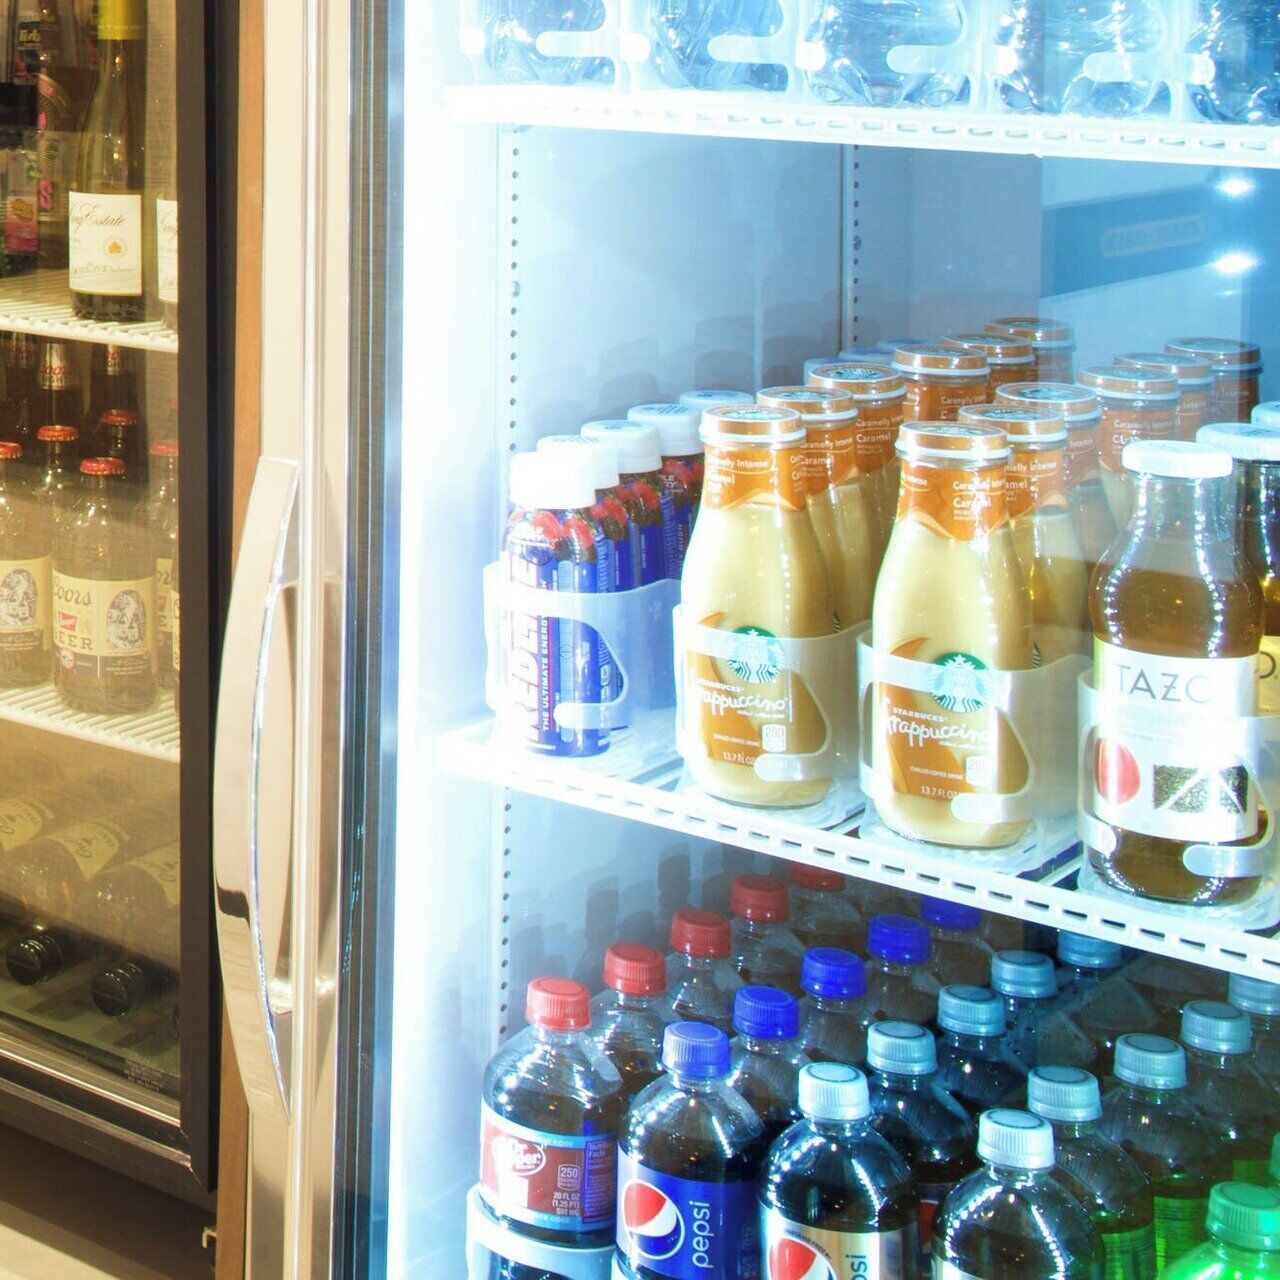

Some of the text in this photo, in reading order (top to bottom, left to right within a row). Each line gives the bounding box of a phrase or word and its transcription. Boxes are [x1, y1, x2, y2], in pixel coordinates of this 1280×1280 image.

[856, 433, 891, 443] Caramel
[55, 632, 93, 651] EER
[560, 1167, 578, 1178] 250
[562, 1192, 570, 1200] FL
[689, 1201, 715, 1269] pepsi
